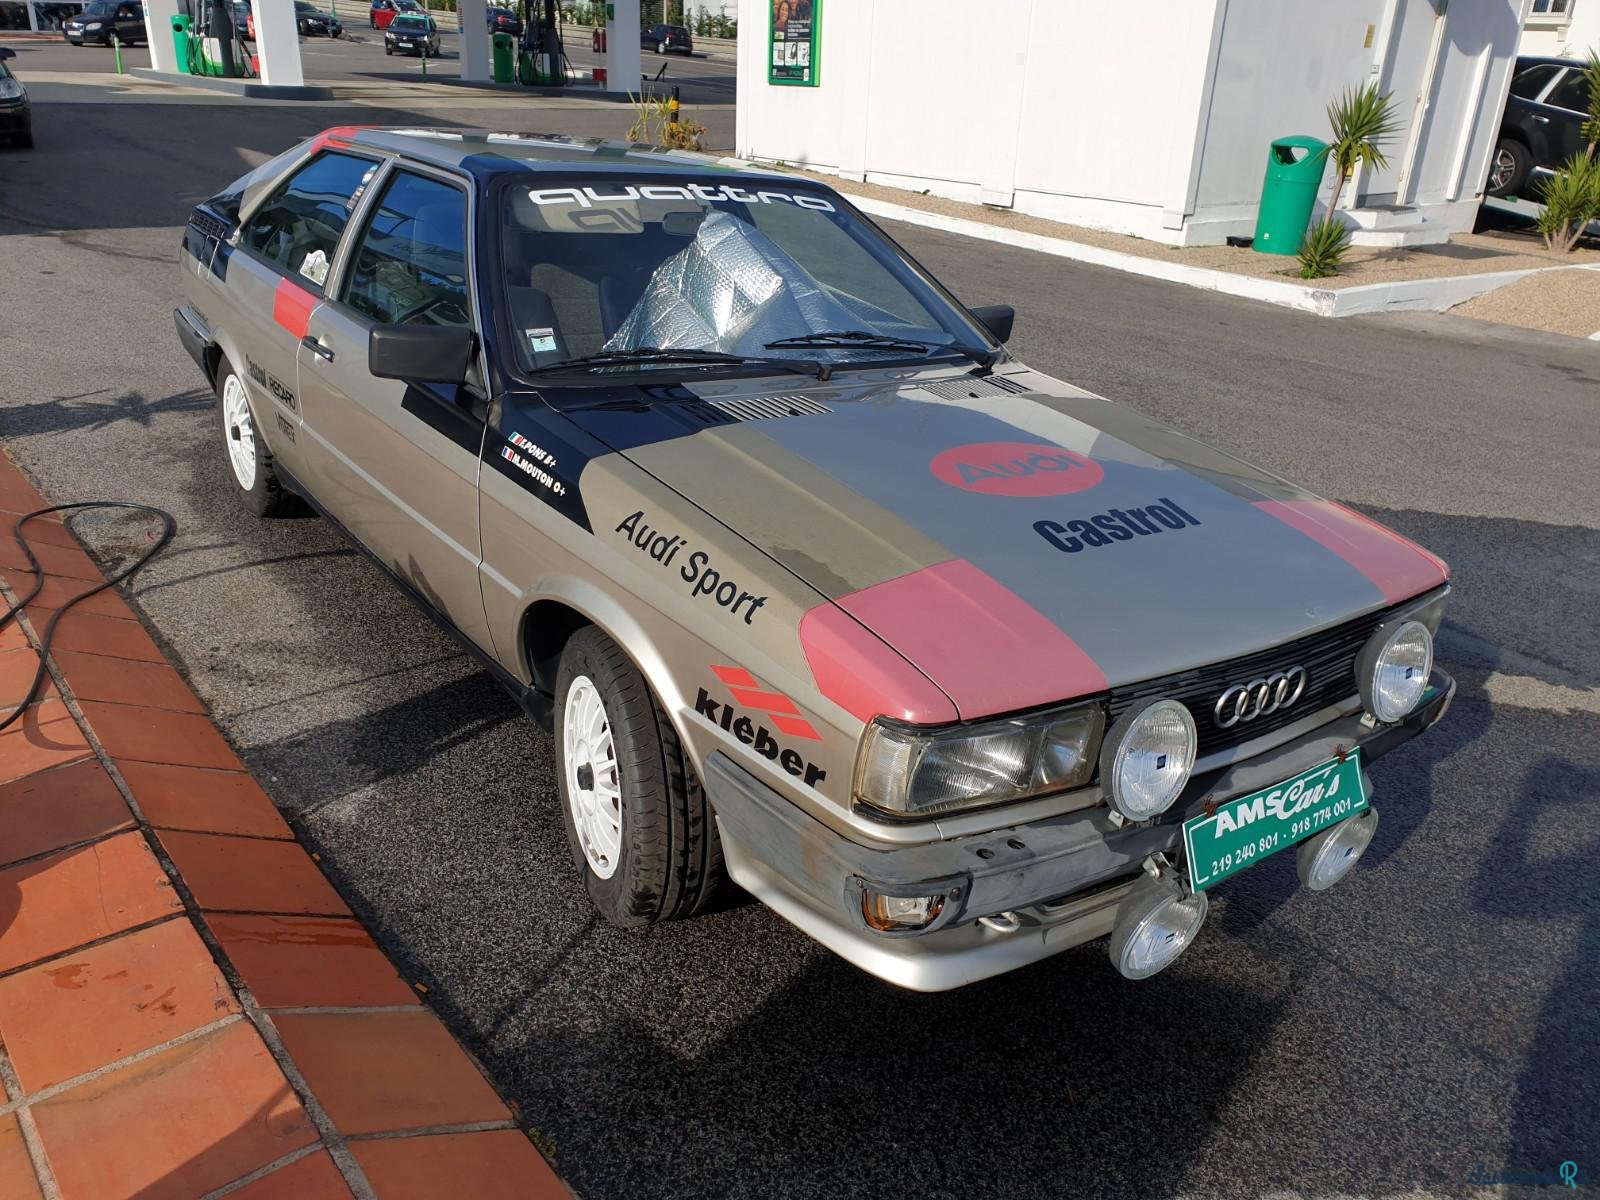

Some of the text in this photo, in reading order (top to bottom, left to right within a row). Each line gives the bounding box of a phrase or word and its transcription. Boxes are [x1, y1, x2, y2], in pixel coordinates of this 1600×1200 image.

[528, 183, 836, 212] quattro
[268, 374, 296, 411] RECARO
[511, 453, 554, 488] M.MOUTON
[955, 452, 1084, 484] Audi
[1032, 497, 1202, 553] Castrol
[615, 510, 769, 625] Audi Sport
[1212, 796, 1352, 876] 219 240 801 918 774 001
